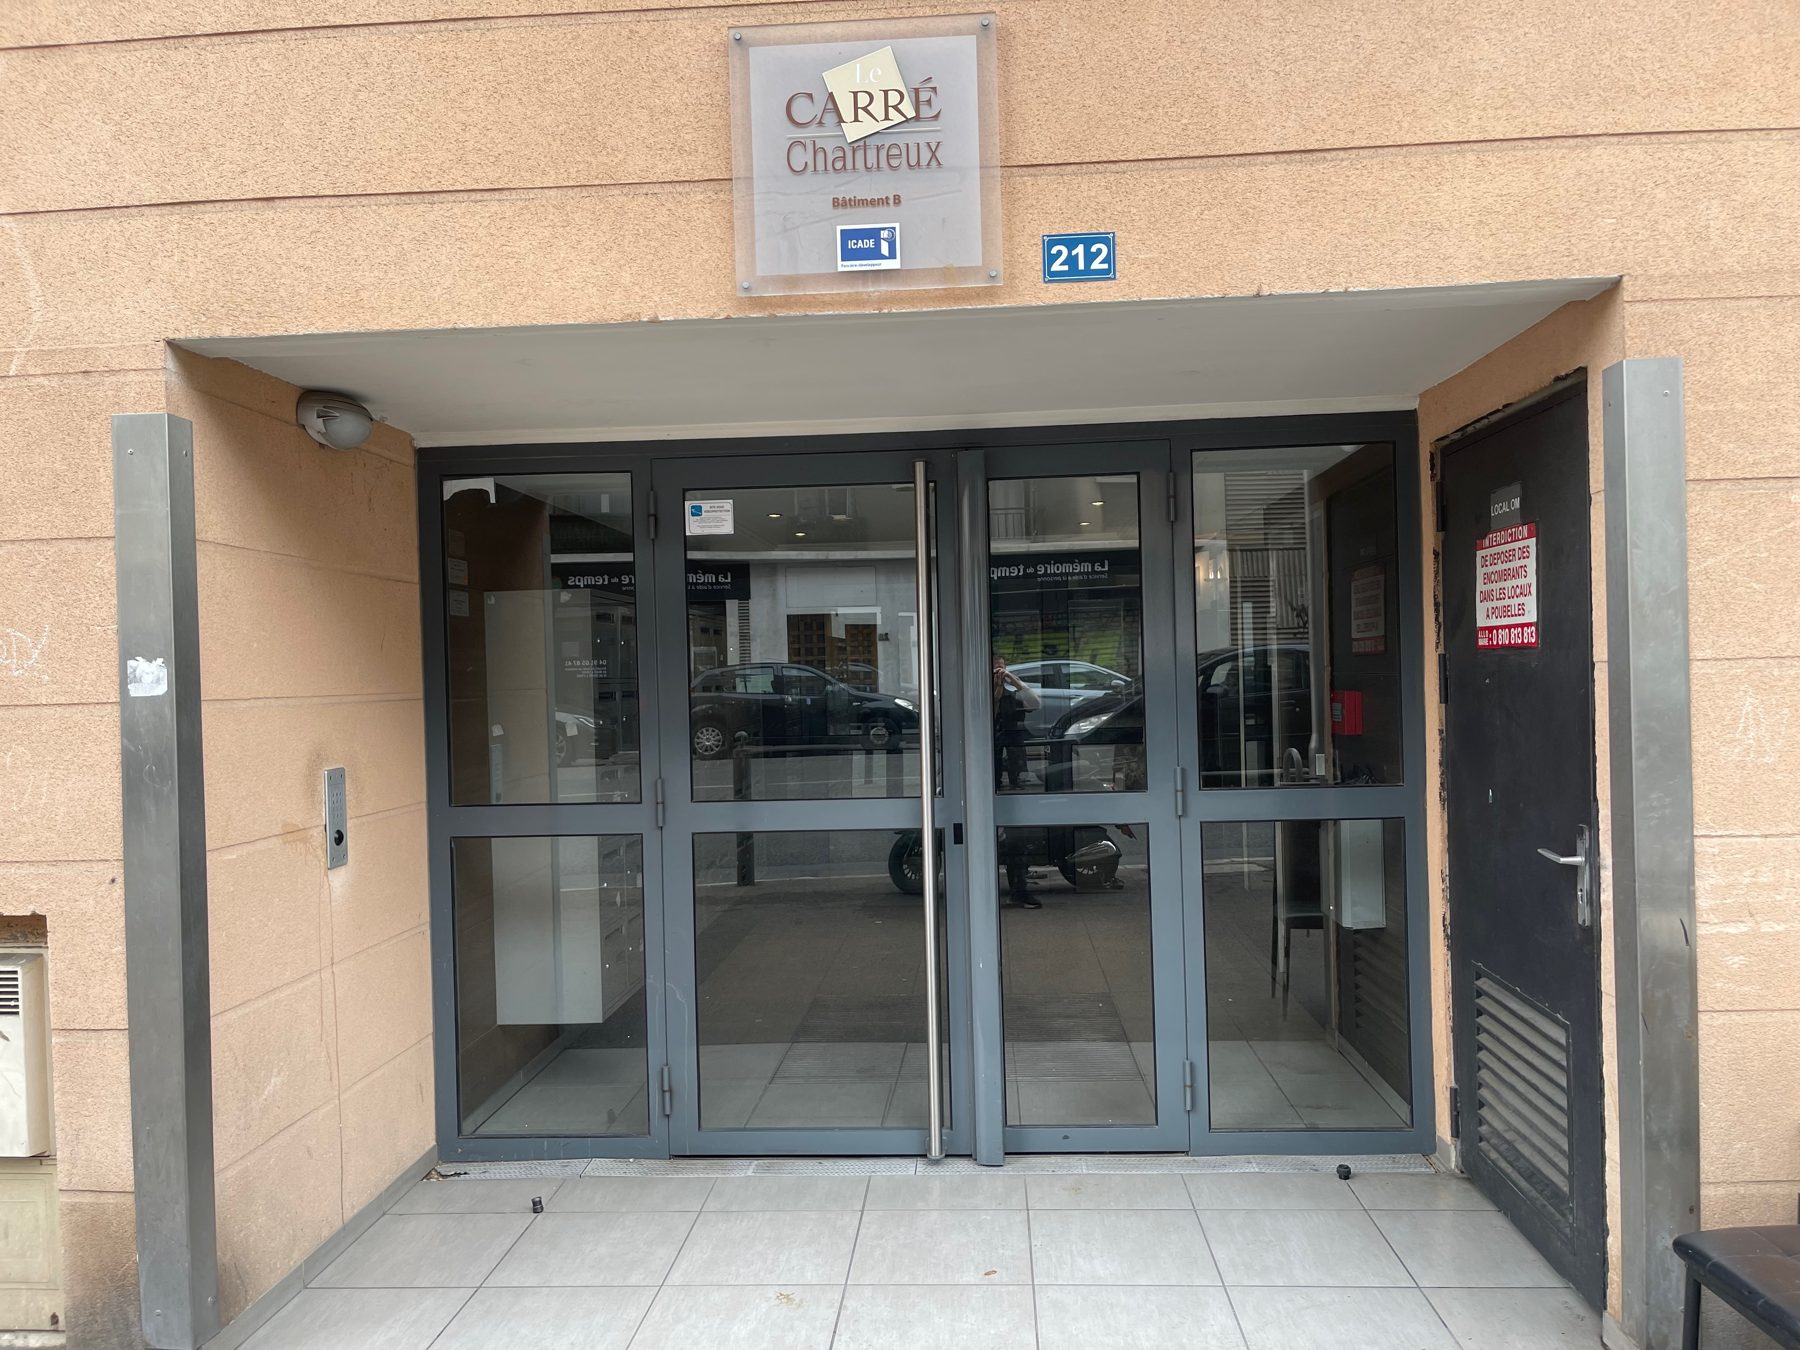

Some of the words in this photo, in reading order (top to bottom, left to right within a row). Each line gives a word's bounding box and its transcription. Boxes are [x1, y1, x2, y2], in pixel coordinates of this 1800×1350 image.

[855, 63, 882, 83] Le
[785, 77, 943, 128] CARRÉ
[786, 139, 944, 174] Chartreux
[832, 195, 890, 209] Bâtiment
[893, 193, 902, 207] B
[848, 238, 876, 249] ICADE
[1049, 243, 1110, 273] 212
[1490, 501, 1510, 516] LOCAL
[1511, 496, 1520, 510] OM
[1482, 524, 1529, 549] INTERDICTION
[1480, 554, 1489, 569] DE
[1489, 548, 1517, 567] DEPOSER
[1518, 544, 1531, 561] DES
[1482, 564, 1528, 586] ENCOMBRANTS
[1480, 588, 1494, 604] DANS
[1495, 586, 1506, 602] LES
[1507, 582, 1533, 600] LOCAUX
[1486, 607, 1490, 620] A
[1491, 602, 1526, 620] POUBELLES
[1498, 628, 1510, 645] 810
[1510, 627, 1522, 644] 813
[1523, 626, 1536, 644] 813
